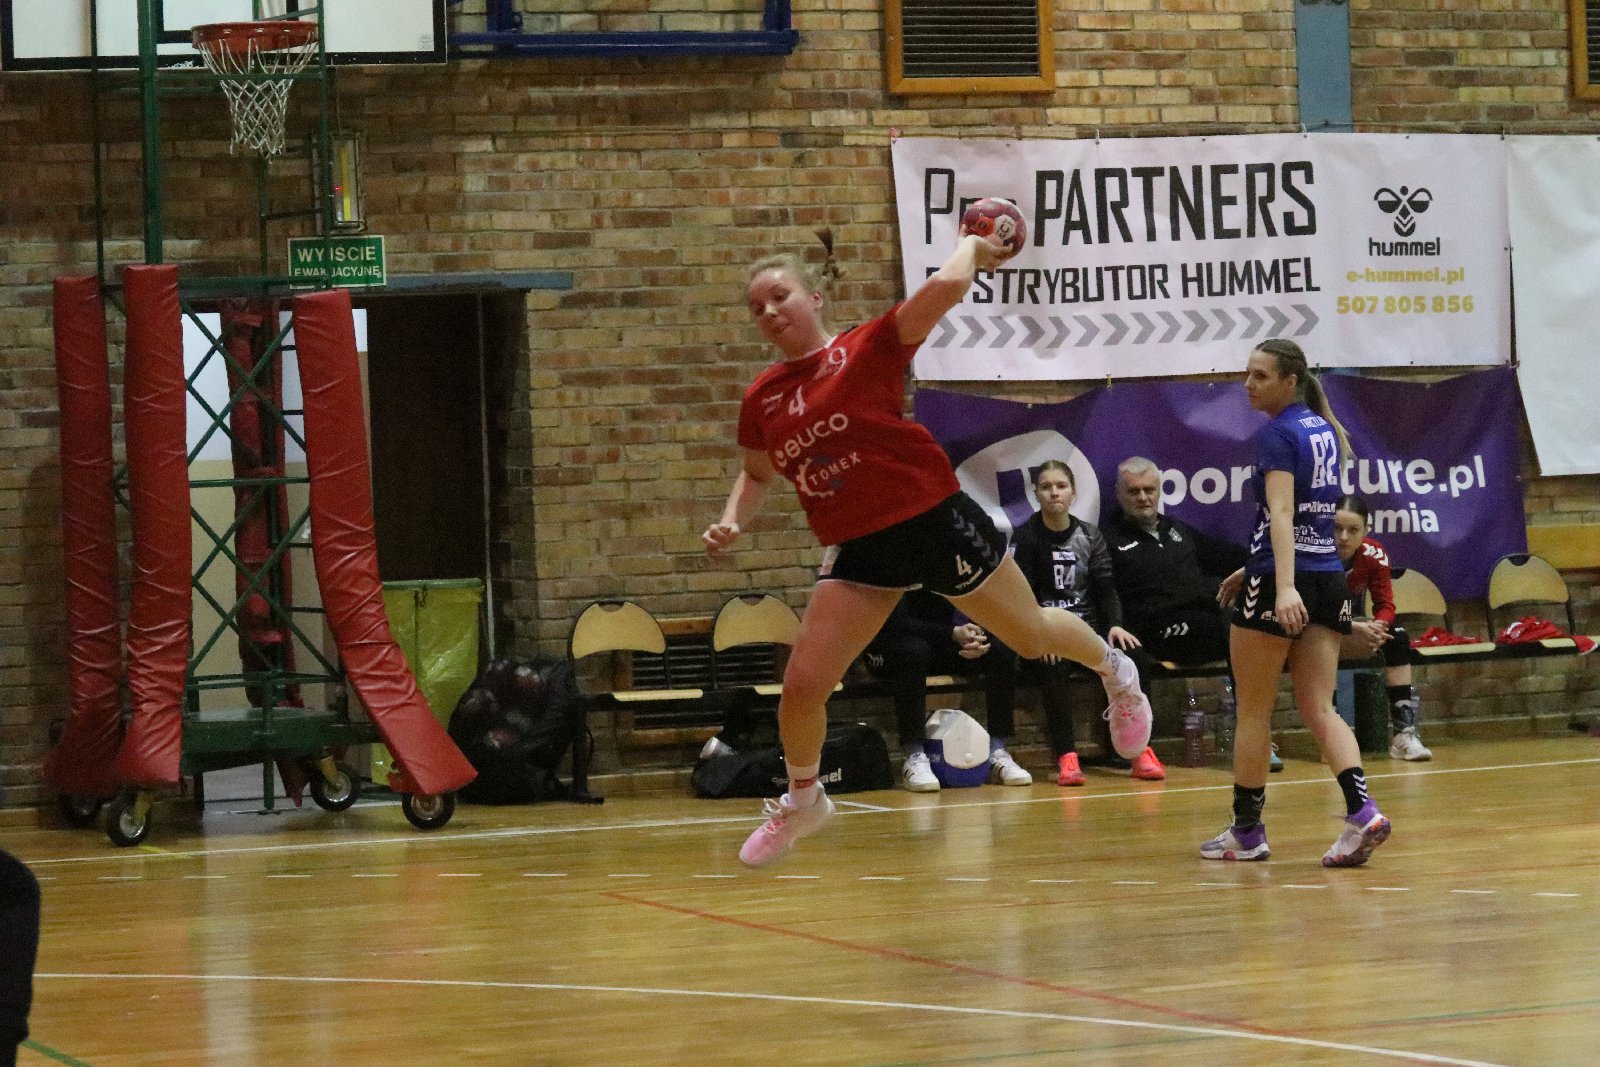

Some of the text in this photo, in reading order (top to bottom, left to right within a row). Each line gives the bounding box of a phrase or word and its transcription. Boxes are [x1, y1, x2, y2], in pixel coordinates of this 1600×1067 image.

[924, 161, 1317, 247] Pr PARTNERS
[1368, 236, 1441, 256] hummel
[926, 257, 1321, 304] STRYBUTOR HUMMEL
[1346, 266, 1465, 285] e-hummel.pl
[1336, 294, 1475, 315] 507 805 856
[788, 385, 806, 416] 4
[955, 553, 972, 576] 4
